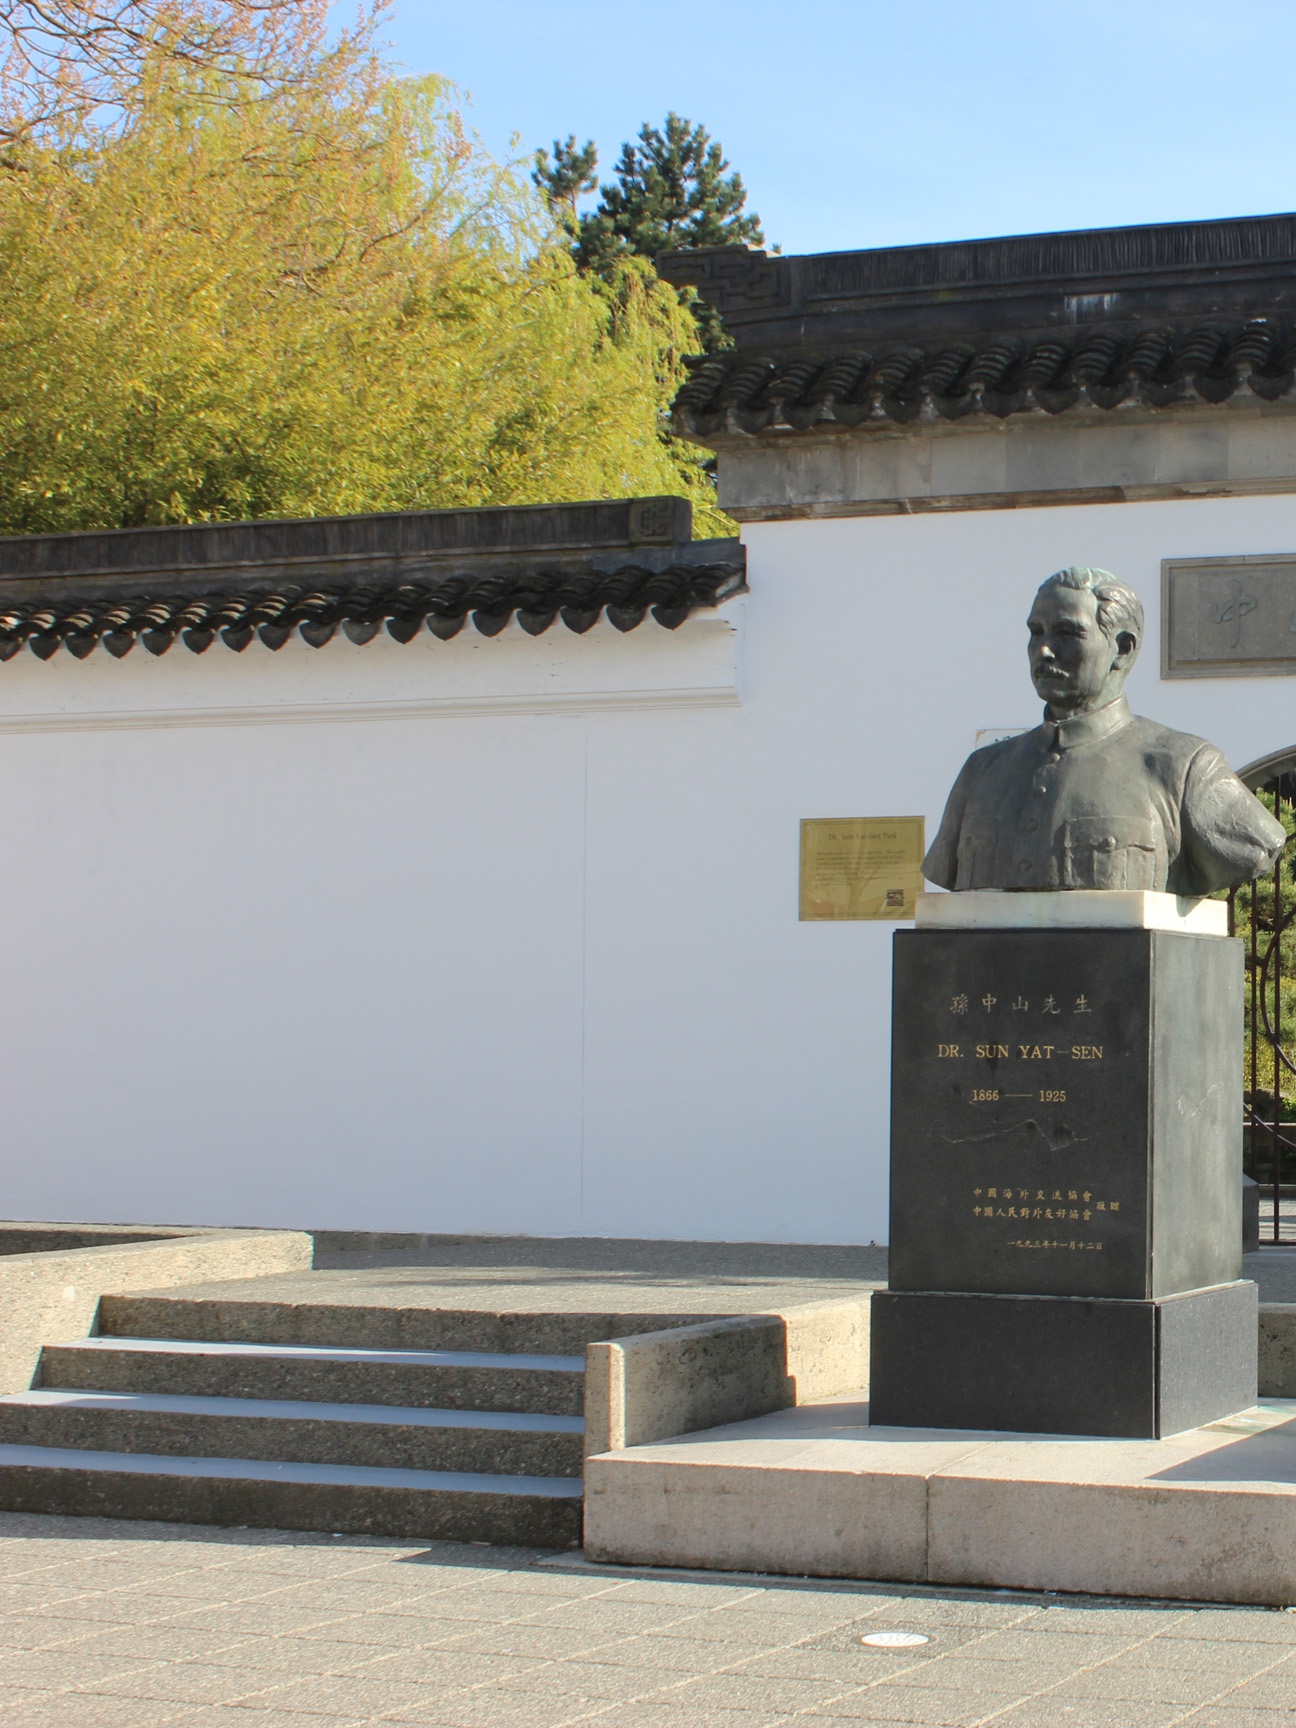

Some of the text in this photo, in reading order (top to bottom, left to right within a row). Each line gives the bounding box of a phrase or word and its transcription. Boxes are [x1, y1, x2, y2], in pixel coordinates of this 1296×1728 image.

[950, 993, 1092, 1015] 孫中山先生
[937, 1044, 964, 1058] DR.
[976, 1045, 1009, 1058] SUN
[972, 1089, 999, 1101] 1866
[1038, 1090, 1066, 1102] 1925
[973, 1187, 1092, 1202] 中國海外交流協會
[973, 1205, 1093, 1221] 中國人民對外友好協會
[1006, 1240, 1103, 1250] 一九九三年十一月十二日
